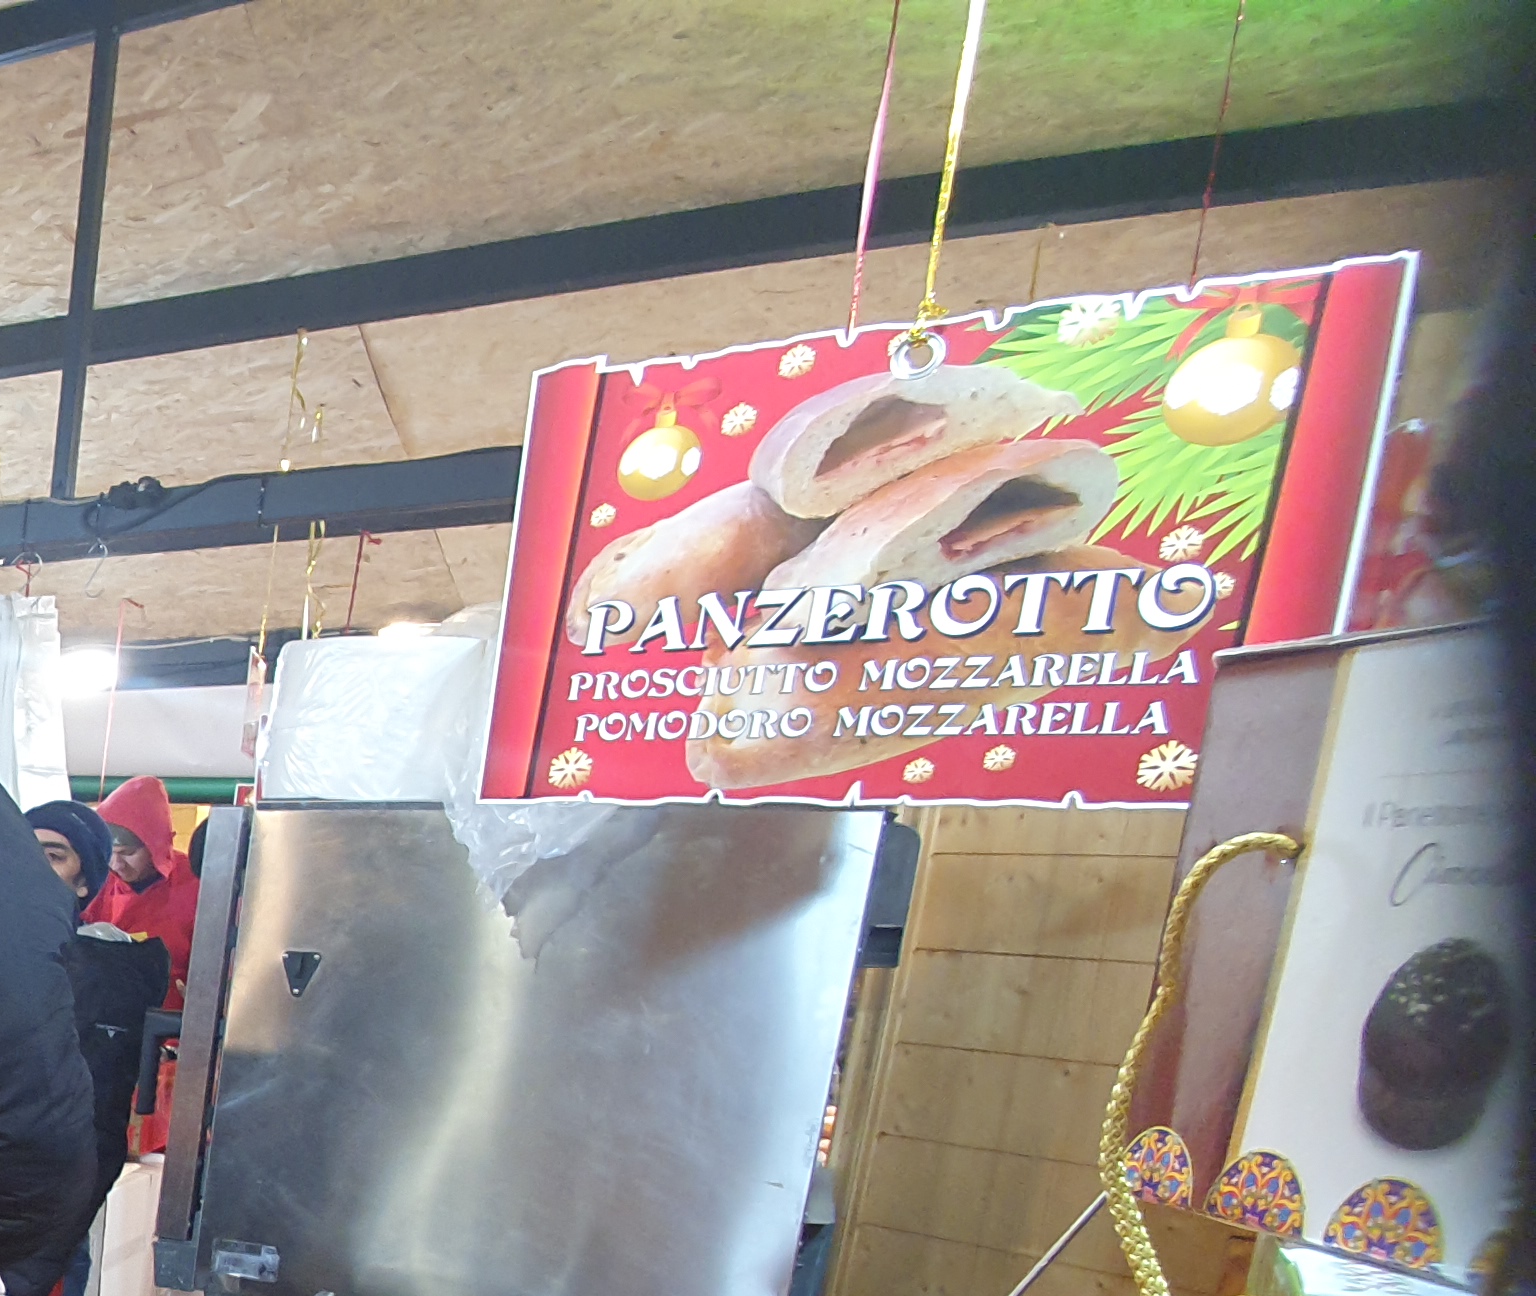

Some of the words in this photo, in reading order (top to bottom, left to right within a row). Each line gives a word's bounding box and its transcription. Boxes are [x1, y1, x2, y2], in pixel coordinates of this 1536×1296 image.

[582, 562, 1215, 657] PANZEROTTO
[567, 661, 839, 702] PROSCIUTTO
[858, 648, 1200, 692] MOZZARELLA
[574, 704, 812, 743] POMODORO
[833, 699, 1168, 739] MOZZARELLA
